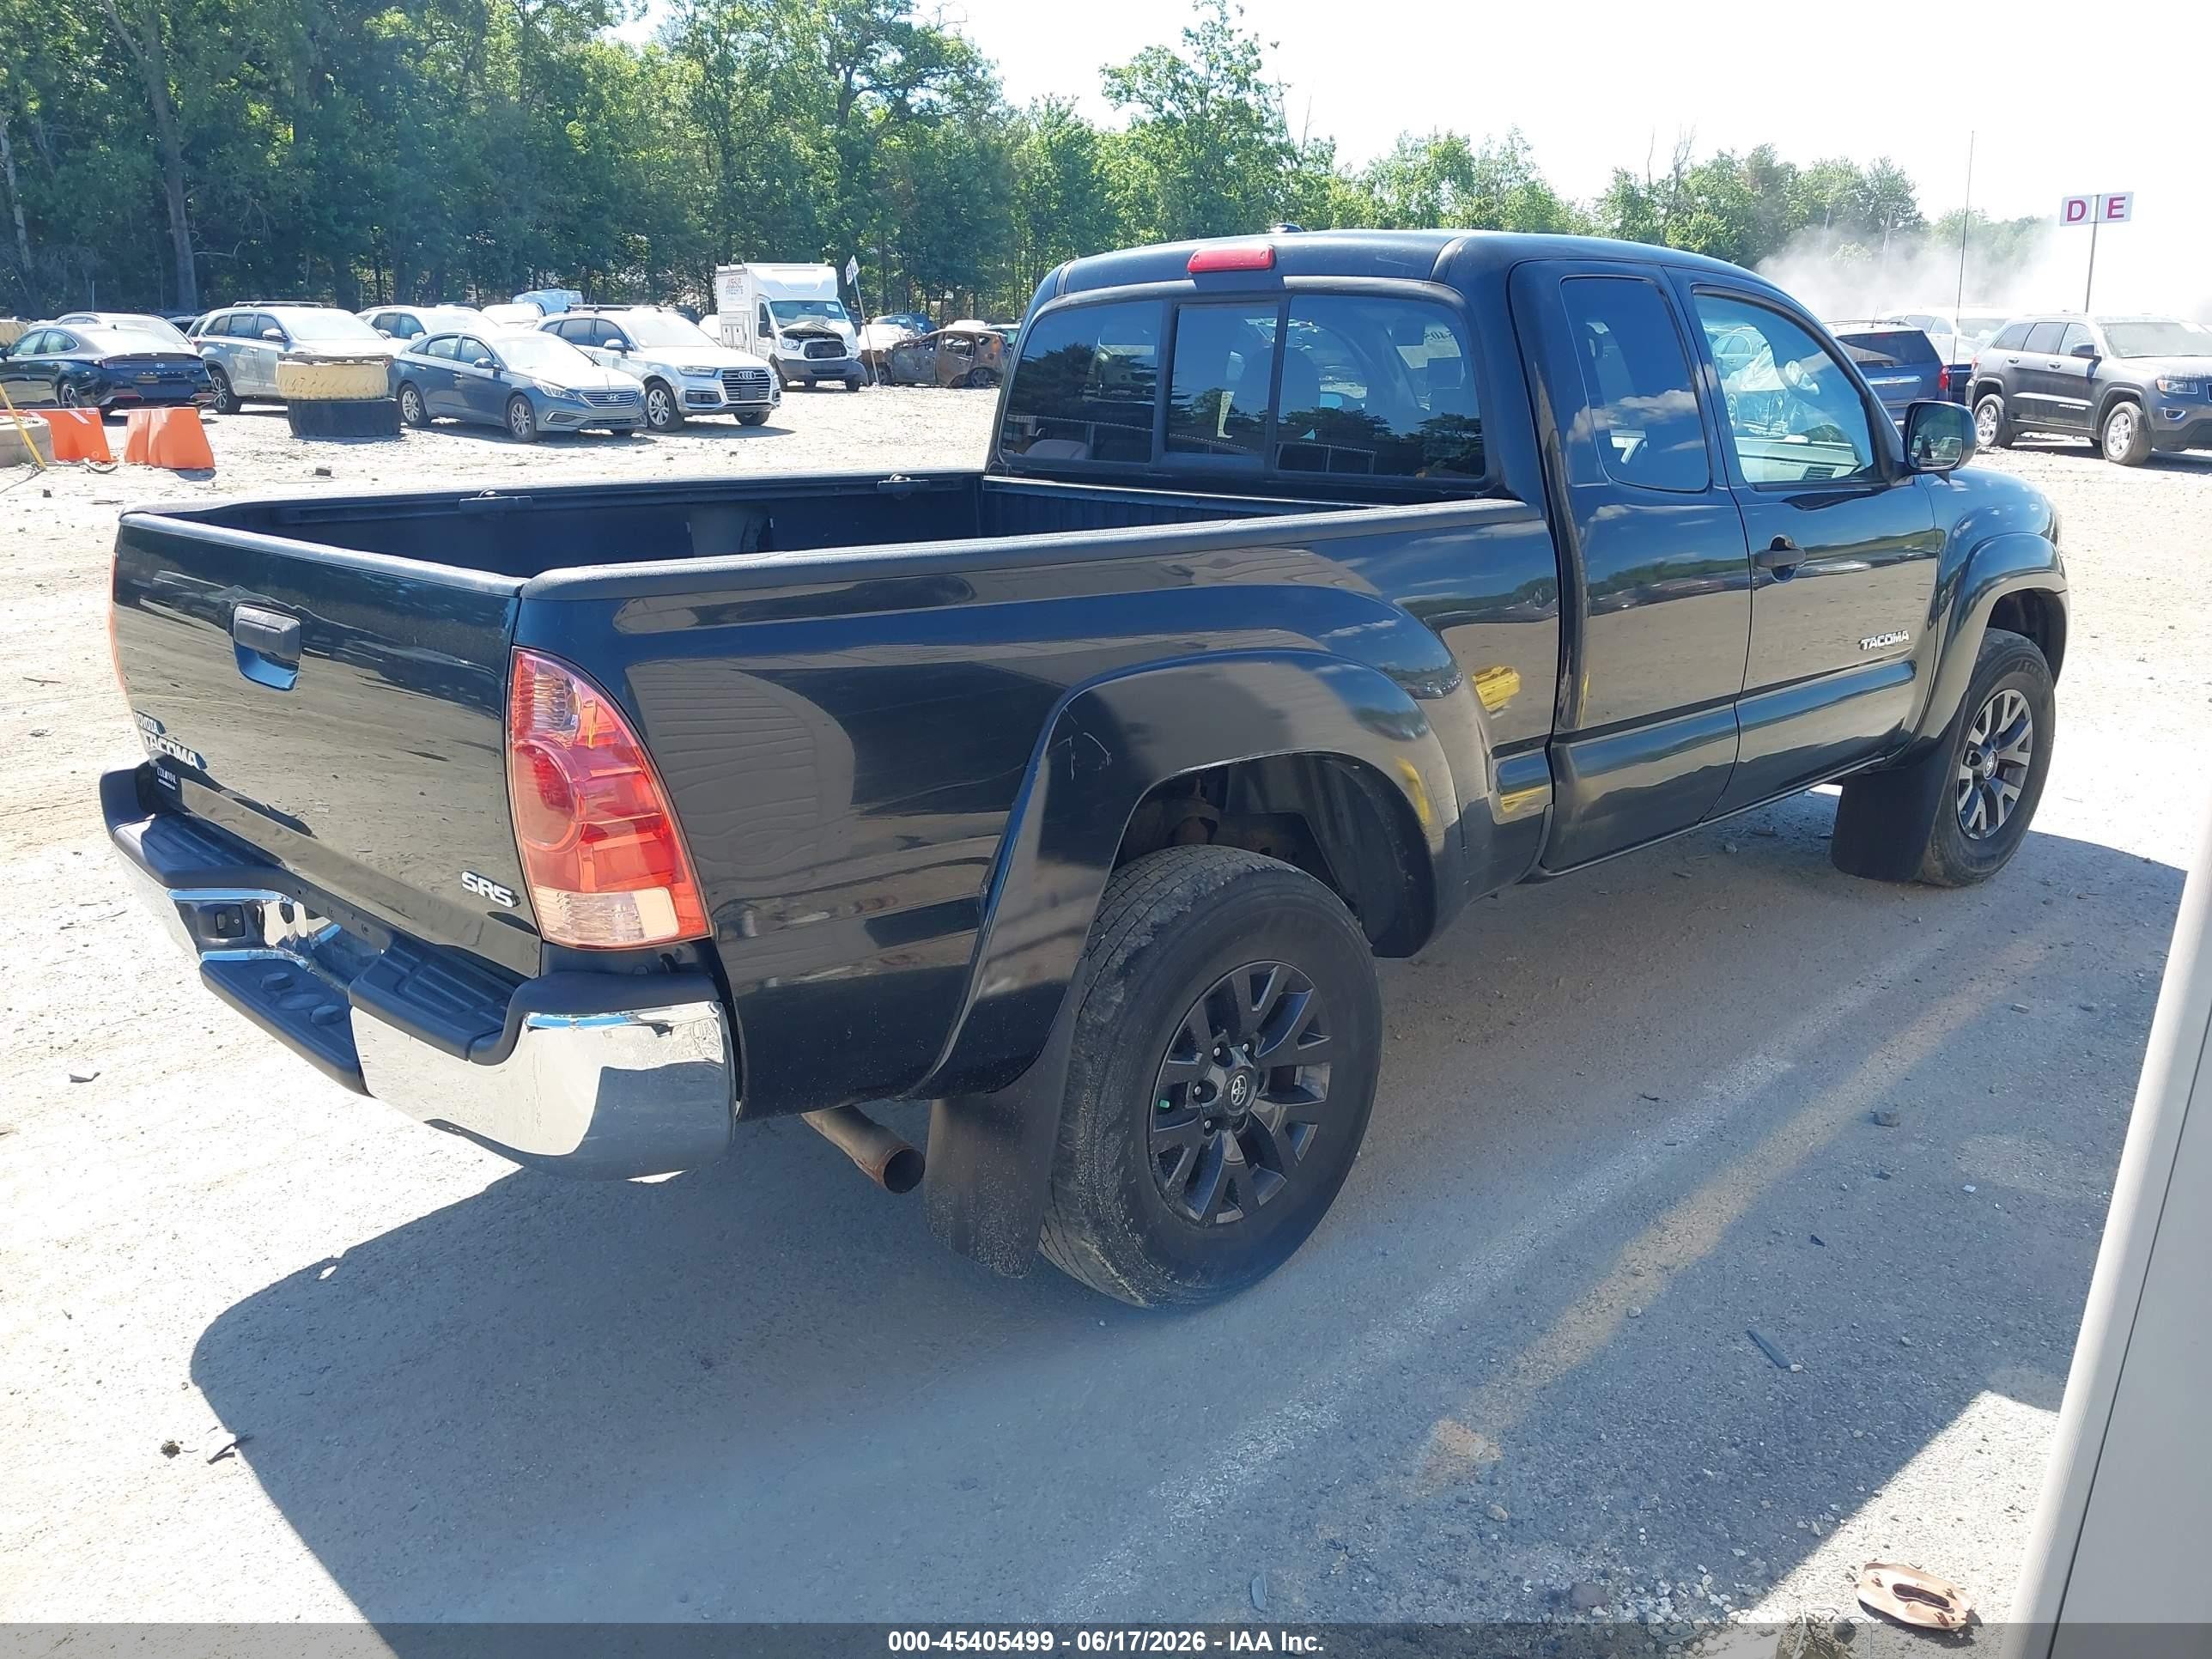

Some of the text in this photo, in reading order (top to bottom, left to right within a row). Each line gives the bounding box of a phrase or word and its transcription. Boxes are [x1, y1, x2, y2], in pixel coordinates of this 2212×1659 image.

[2067, 197, 2126, 222] D E
[1860, 630, 1910, 650] TACOMA
[461, 871, 515, 908] SR5
